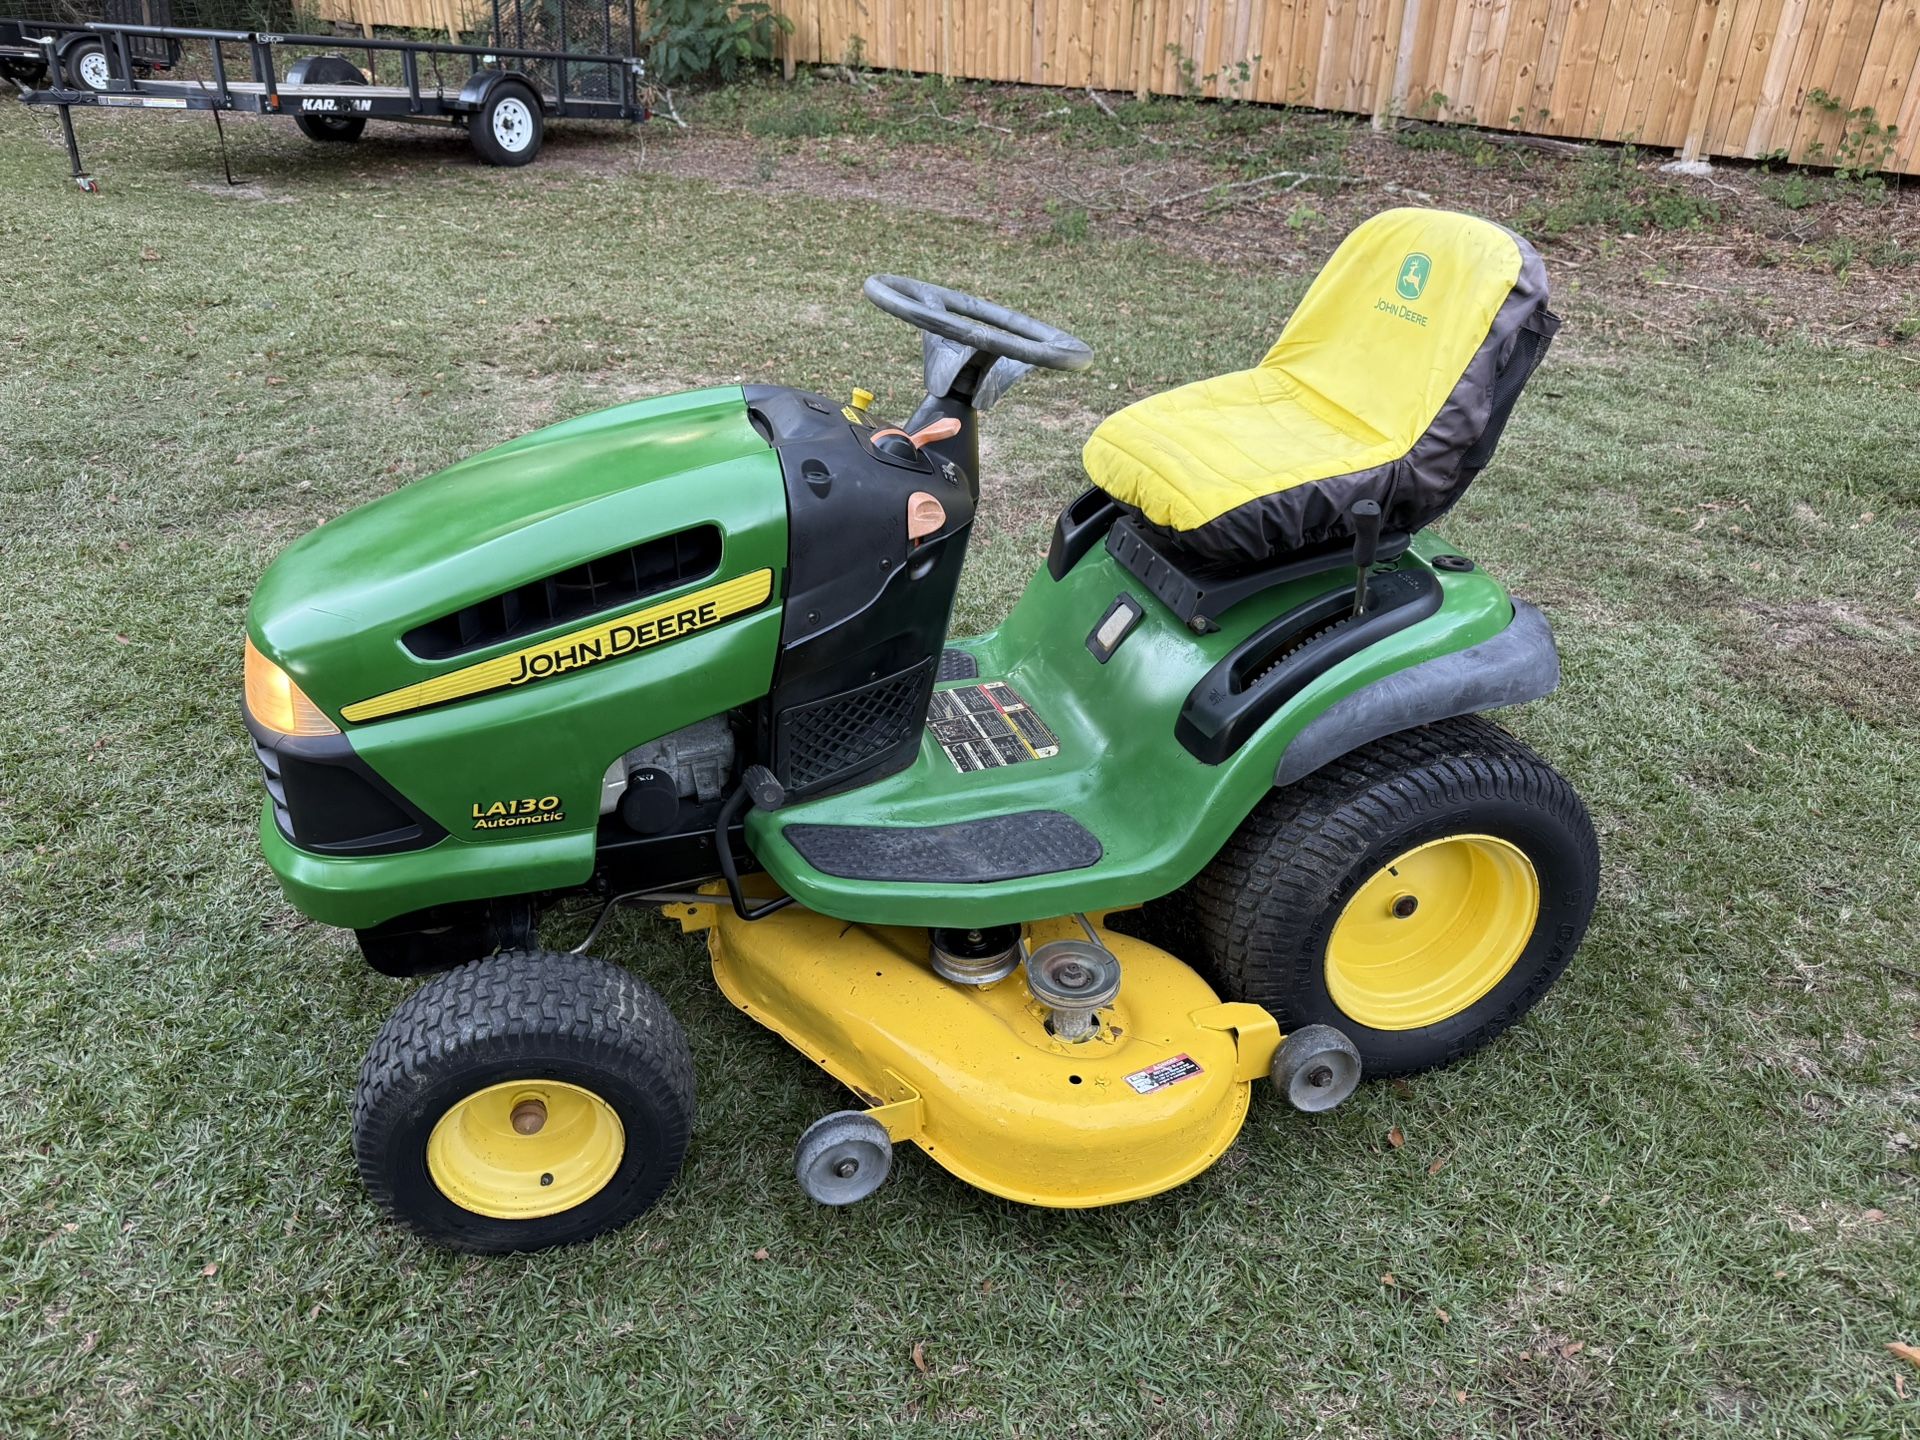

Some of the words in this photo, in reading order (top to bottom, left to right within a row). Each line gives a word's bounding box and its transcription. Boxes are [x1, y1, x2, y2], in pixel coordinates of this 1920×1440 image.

[302, 98, 372, 111] KARAN
[1374, 298, 1398, 315] JOHN
[1399, 305, 1428, 326] DEERE
[510, 638, 602, 683] JOHN
[609, 601, 718, 653] DEERE
[472, 795, 560, 818] LA130
[474, 812, 564, 829] Automatic
